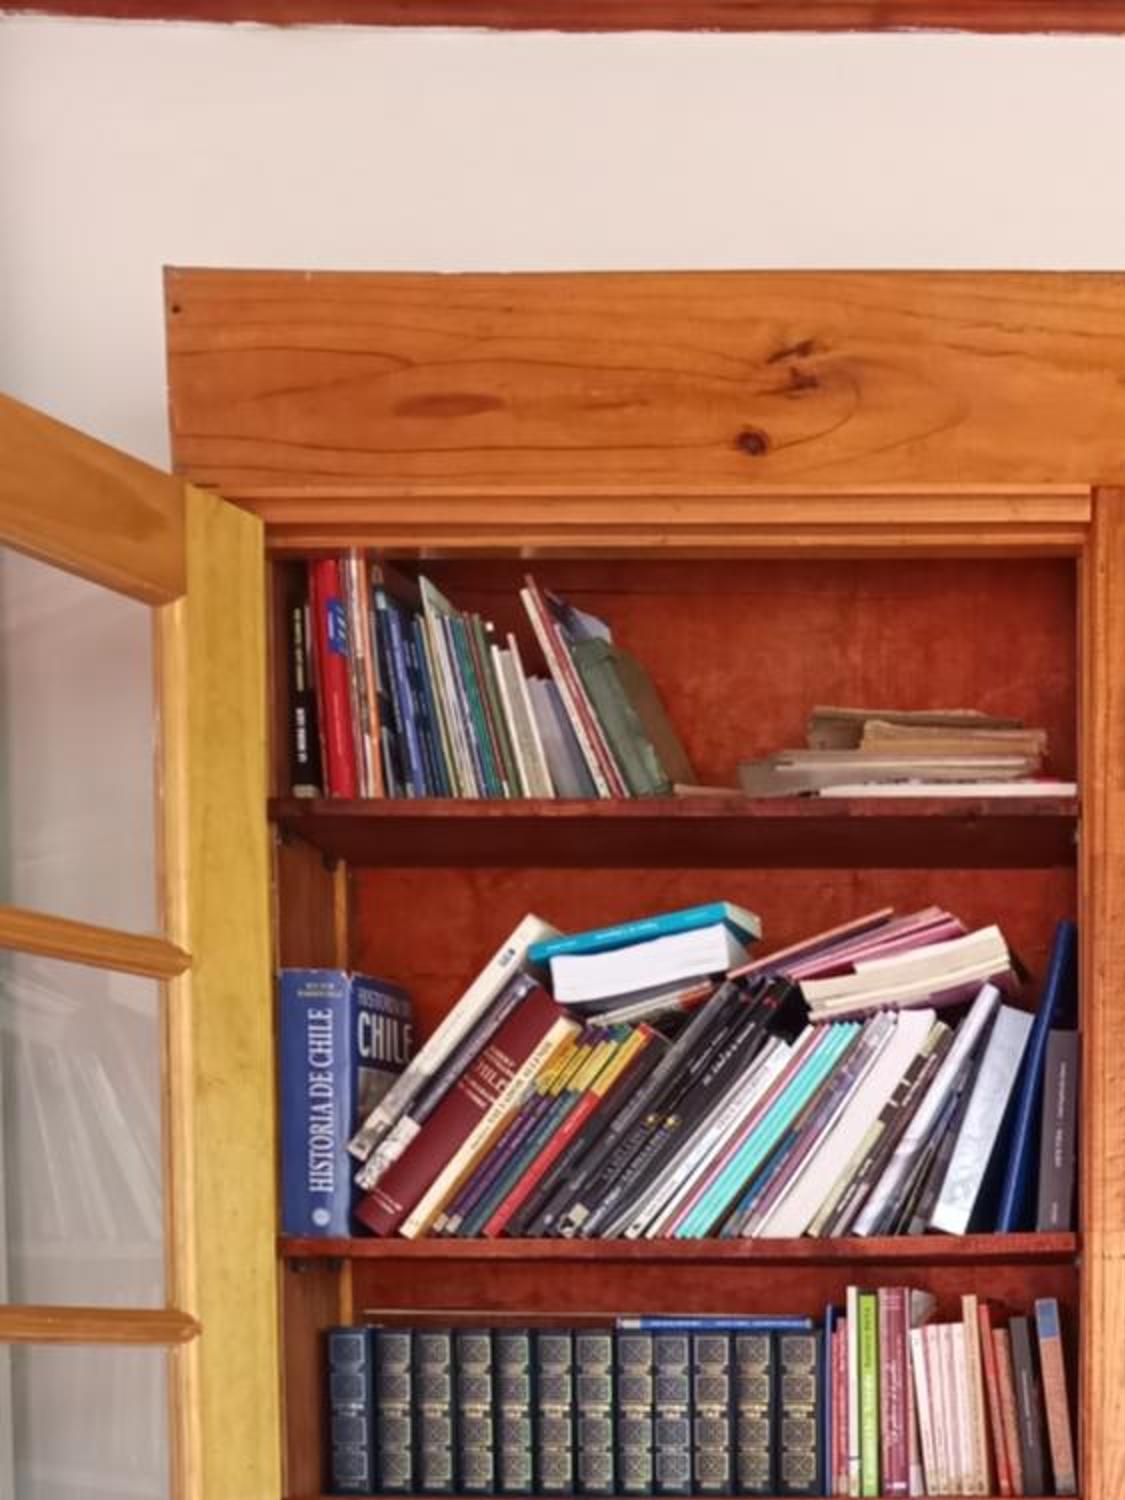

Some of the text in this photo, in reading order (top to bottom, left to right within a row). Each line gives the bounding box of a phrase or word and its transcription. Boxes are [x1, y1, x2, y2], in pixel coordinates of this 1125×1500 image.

[307, 1007, 334, 1068] CHILE
[358, 1011, 414, 1063] CHILE
[308, 1071, 334, 1098] DE
[308, 1103, 335, 1192] HISTORIA
